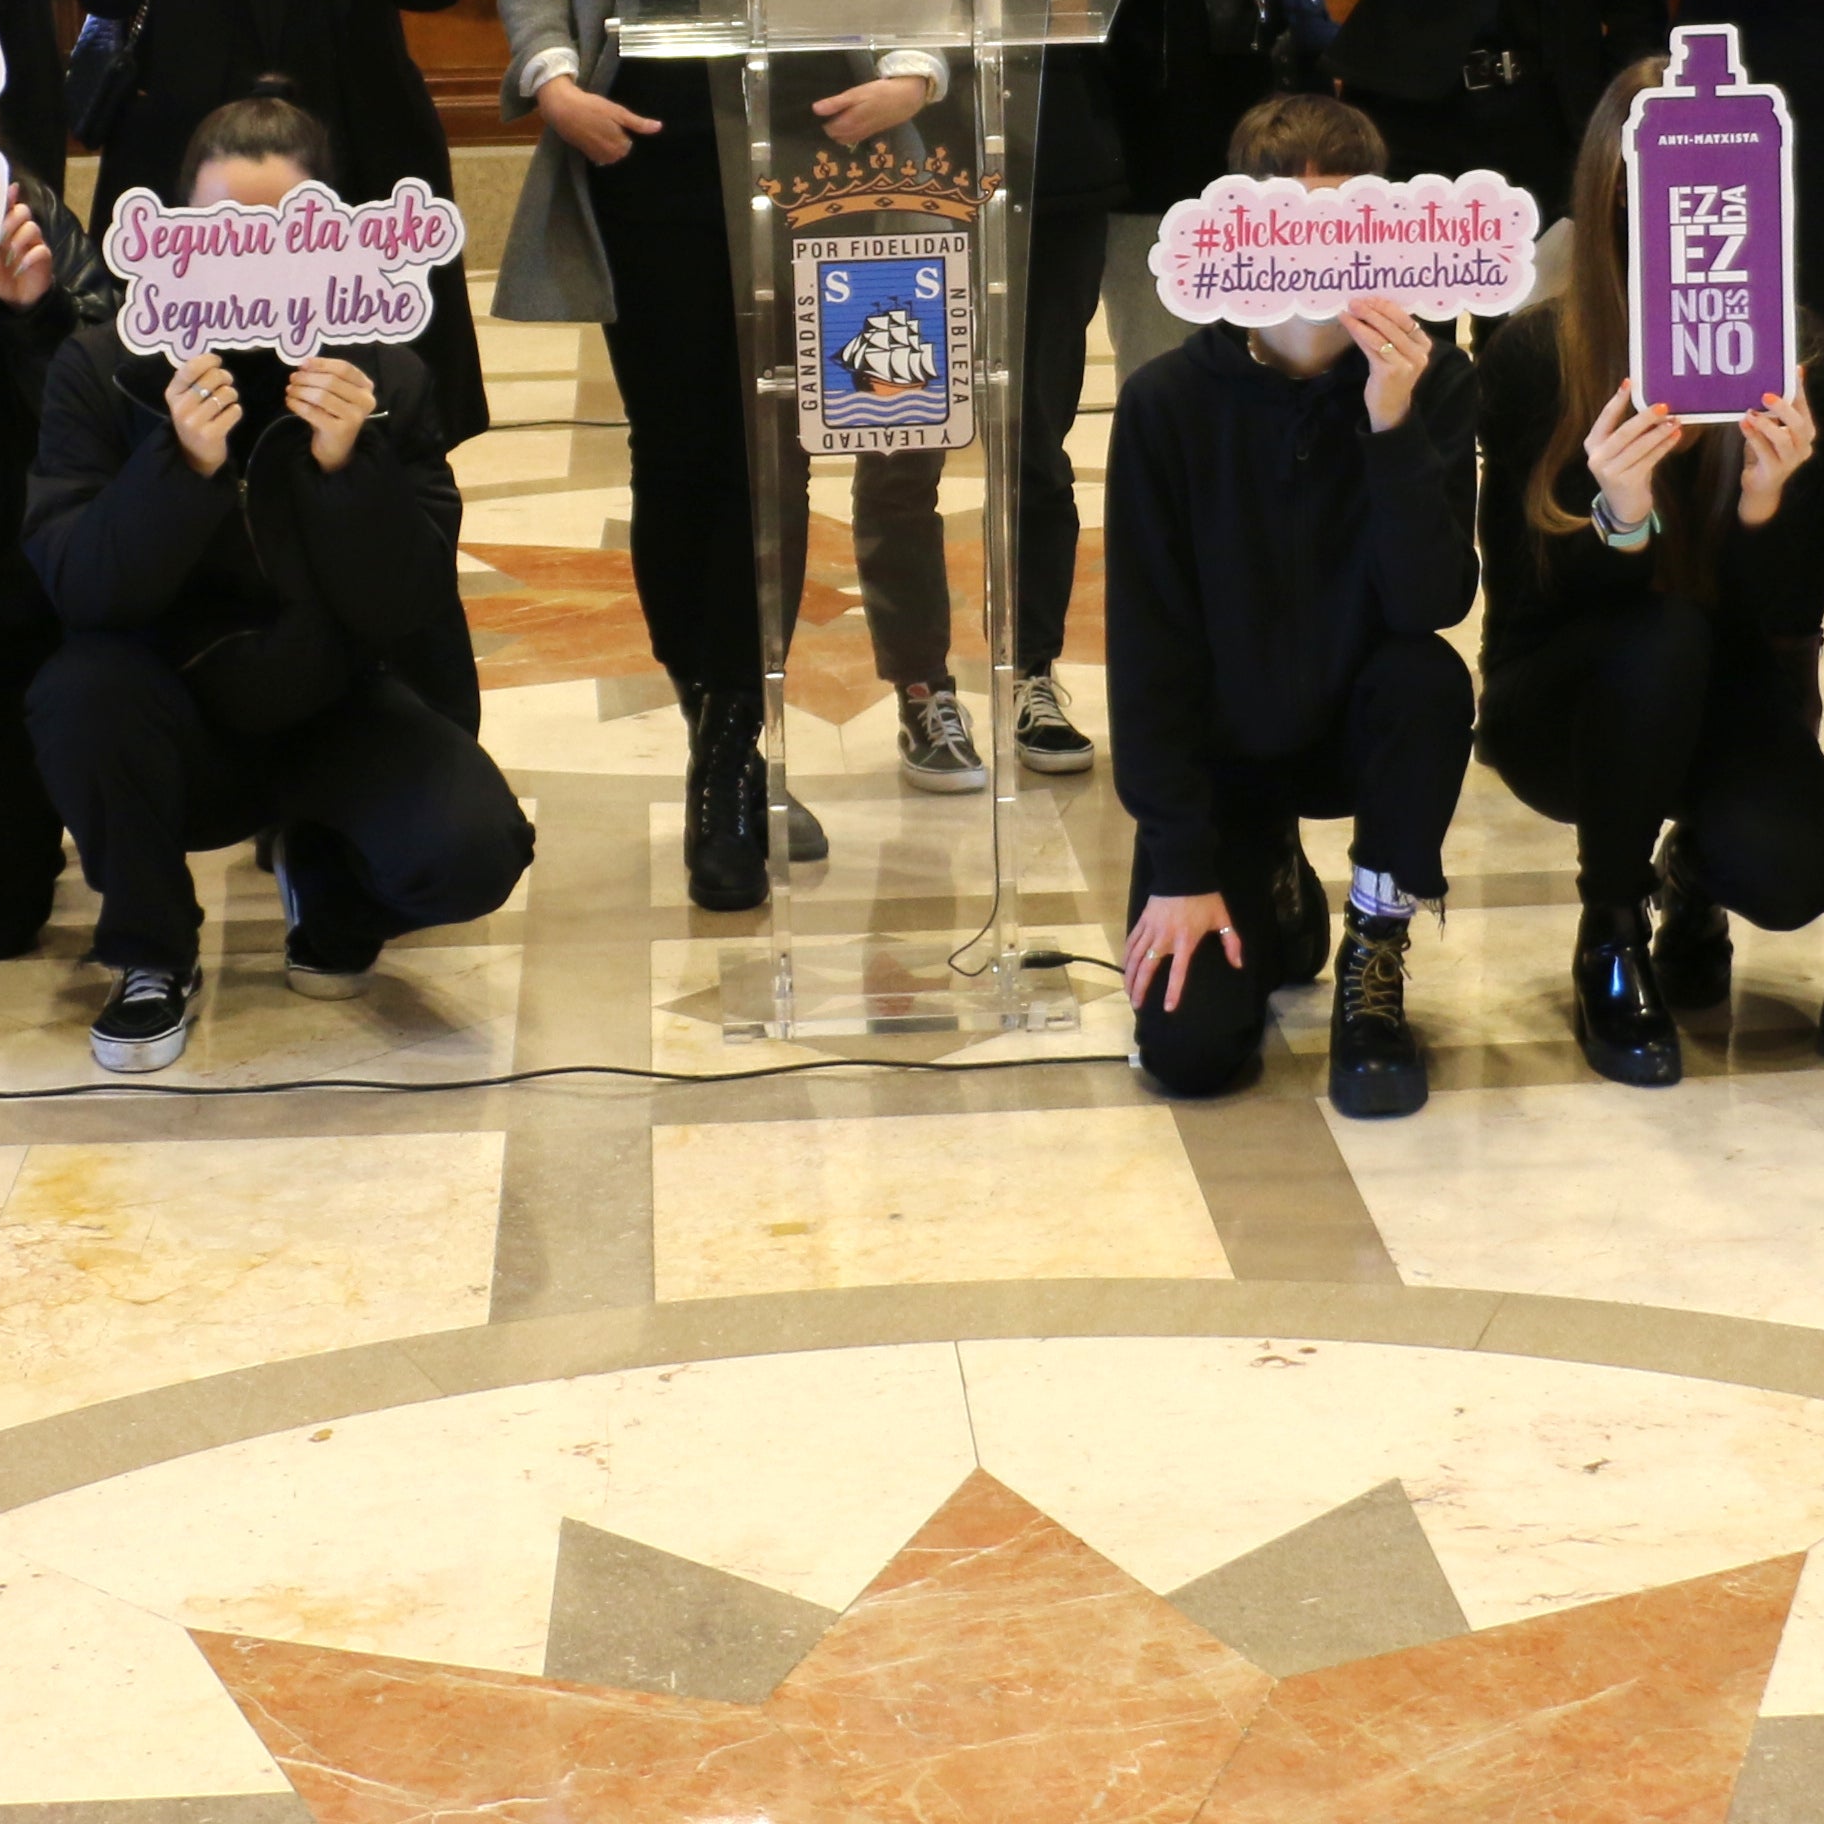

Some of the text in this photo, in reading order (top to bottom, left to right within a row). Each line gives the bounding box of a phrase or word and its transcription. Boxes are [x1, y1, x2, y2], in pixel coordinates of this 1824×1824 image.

[1658, 132, 1759, 146] ANTI-MATXISTA
[1192, 198, 1502, 258] #stickerantimatxista
[1669, 184, 1747, 224] EZ DA
[123, 195, 447, 278] Seguru eta aske
[796, 236, 966, 259] POR FIDELIDAD
[1670, 224, 1748, 284] EZ
[825, 267, 941, 303] S S
[1192, 248, 1508, 300] #stickerantimachista
[136, 275, 414, 350] Segura y libre
[1671, 288, 1750, 323] NO ES
[950, 288, 969, 405] NOBLEZA
[1671, 321, 1754, 376] NO
[823, 428, 951, 450] Y LEALTAD
